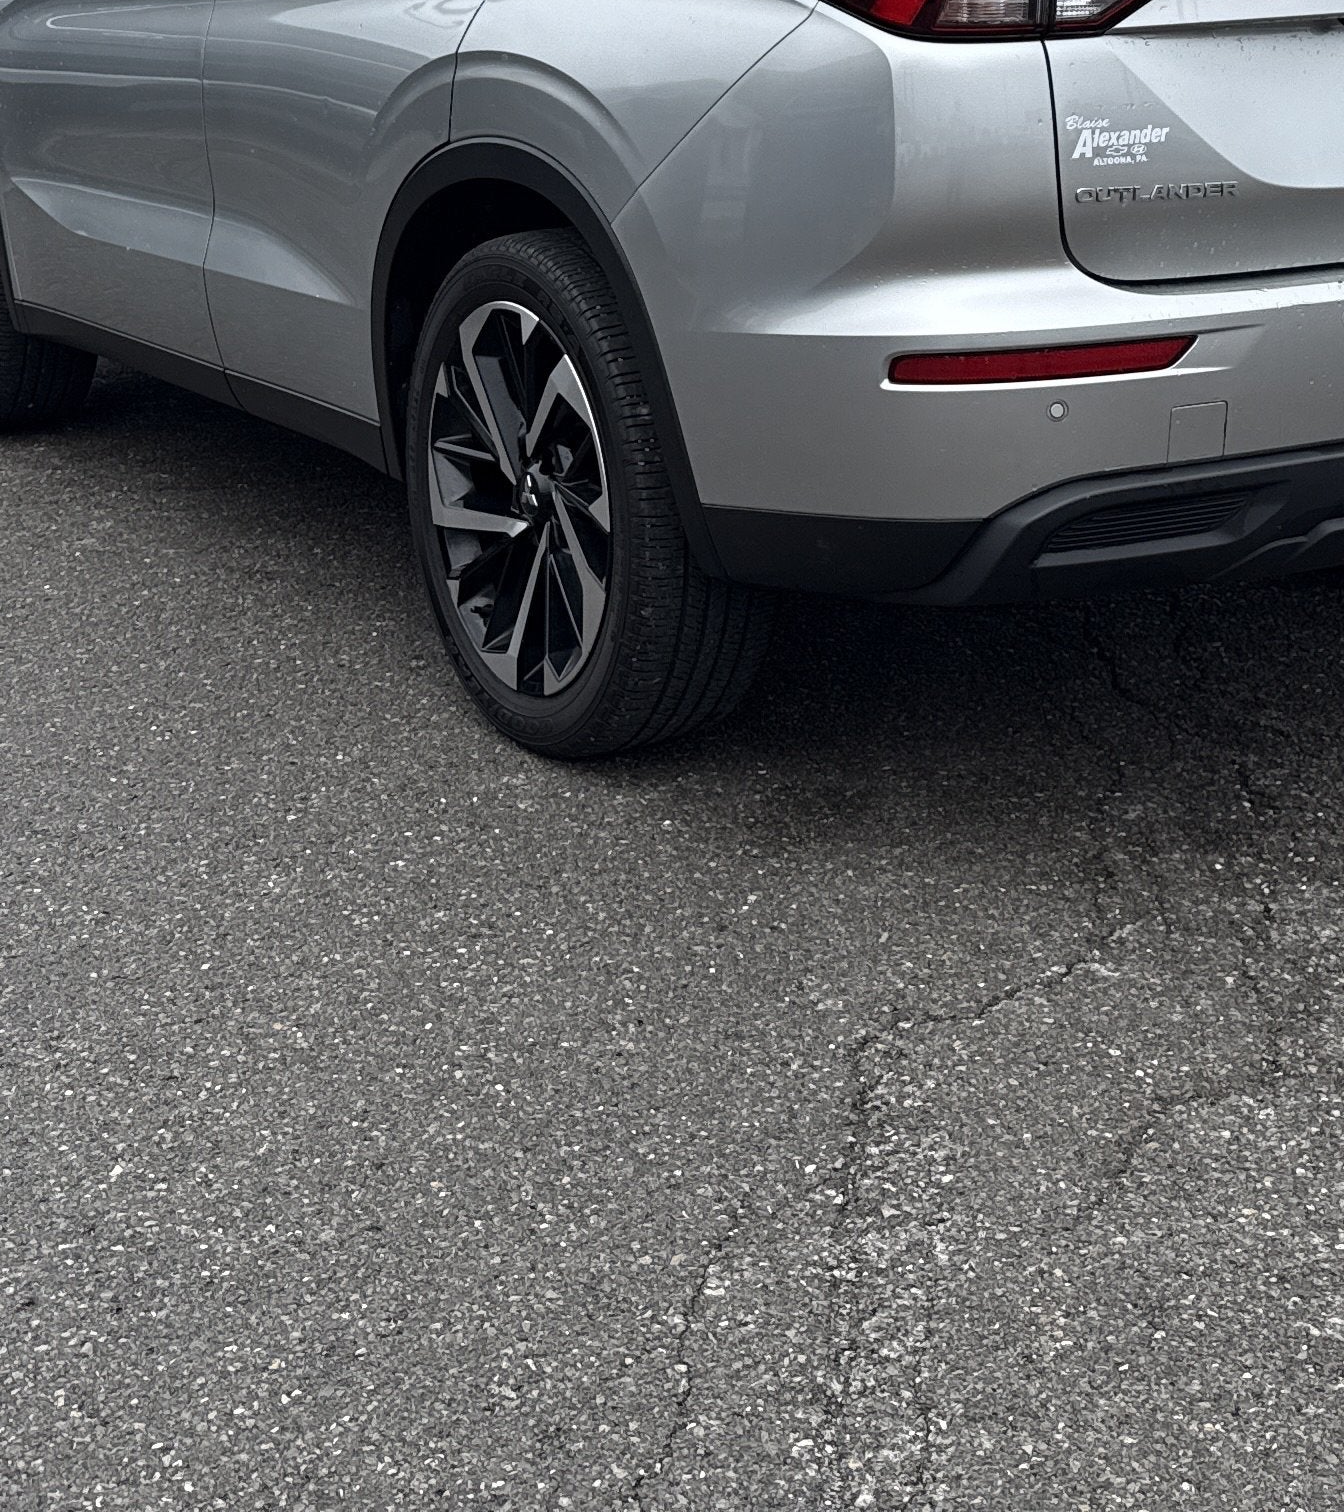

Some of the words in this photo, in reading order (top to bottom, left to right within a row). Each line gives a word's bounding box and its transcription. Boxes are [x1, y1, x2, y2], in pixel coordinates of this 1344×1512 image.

[1065, 114, 1110, 130] Blaise
[1072, 125, 1170, 159] Alexander
[1093, 156, 1135, 166] ALTOONA,
[1135, 154, 1148, 163] PA
[1075, 180, 1239, 203] OUTLANDER
